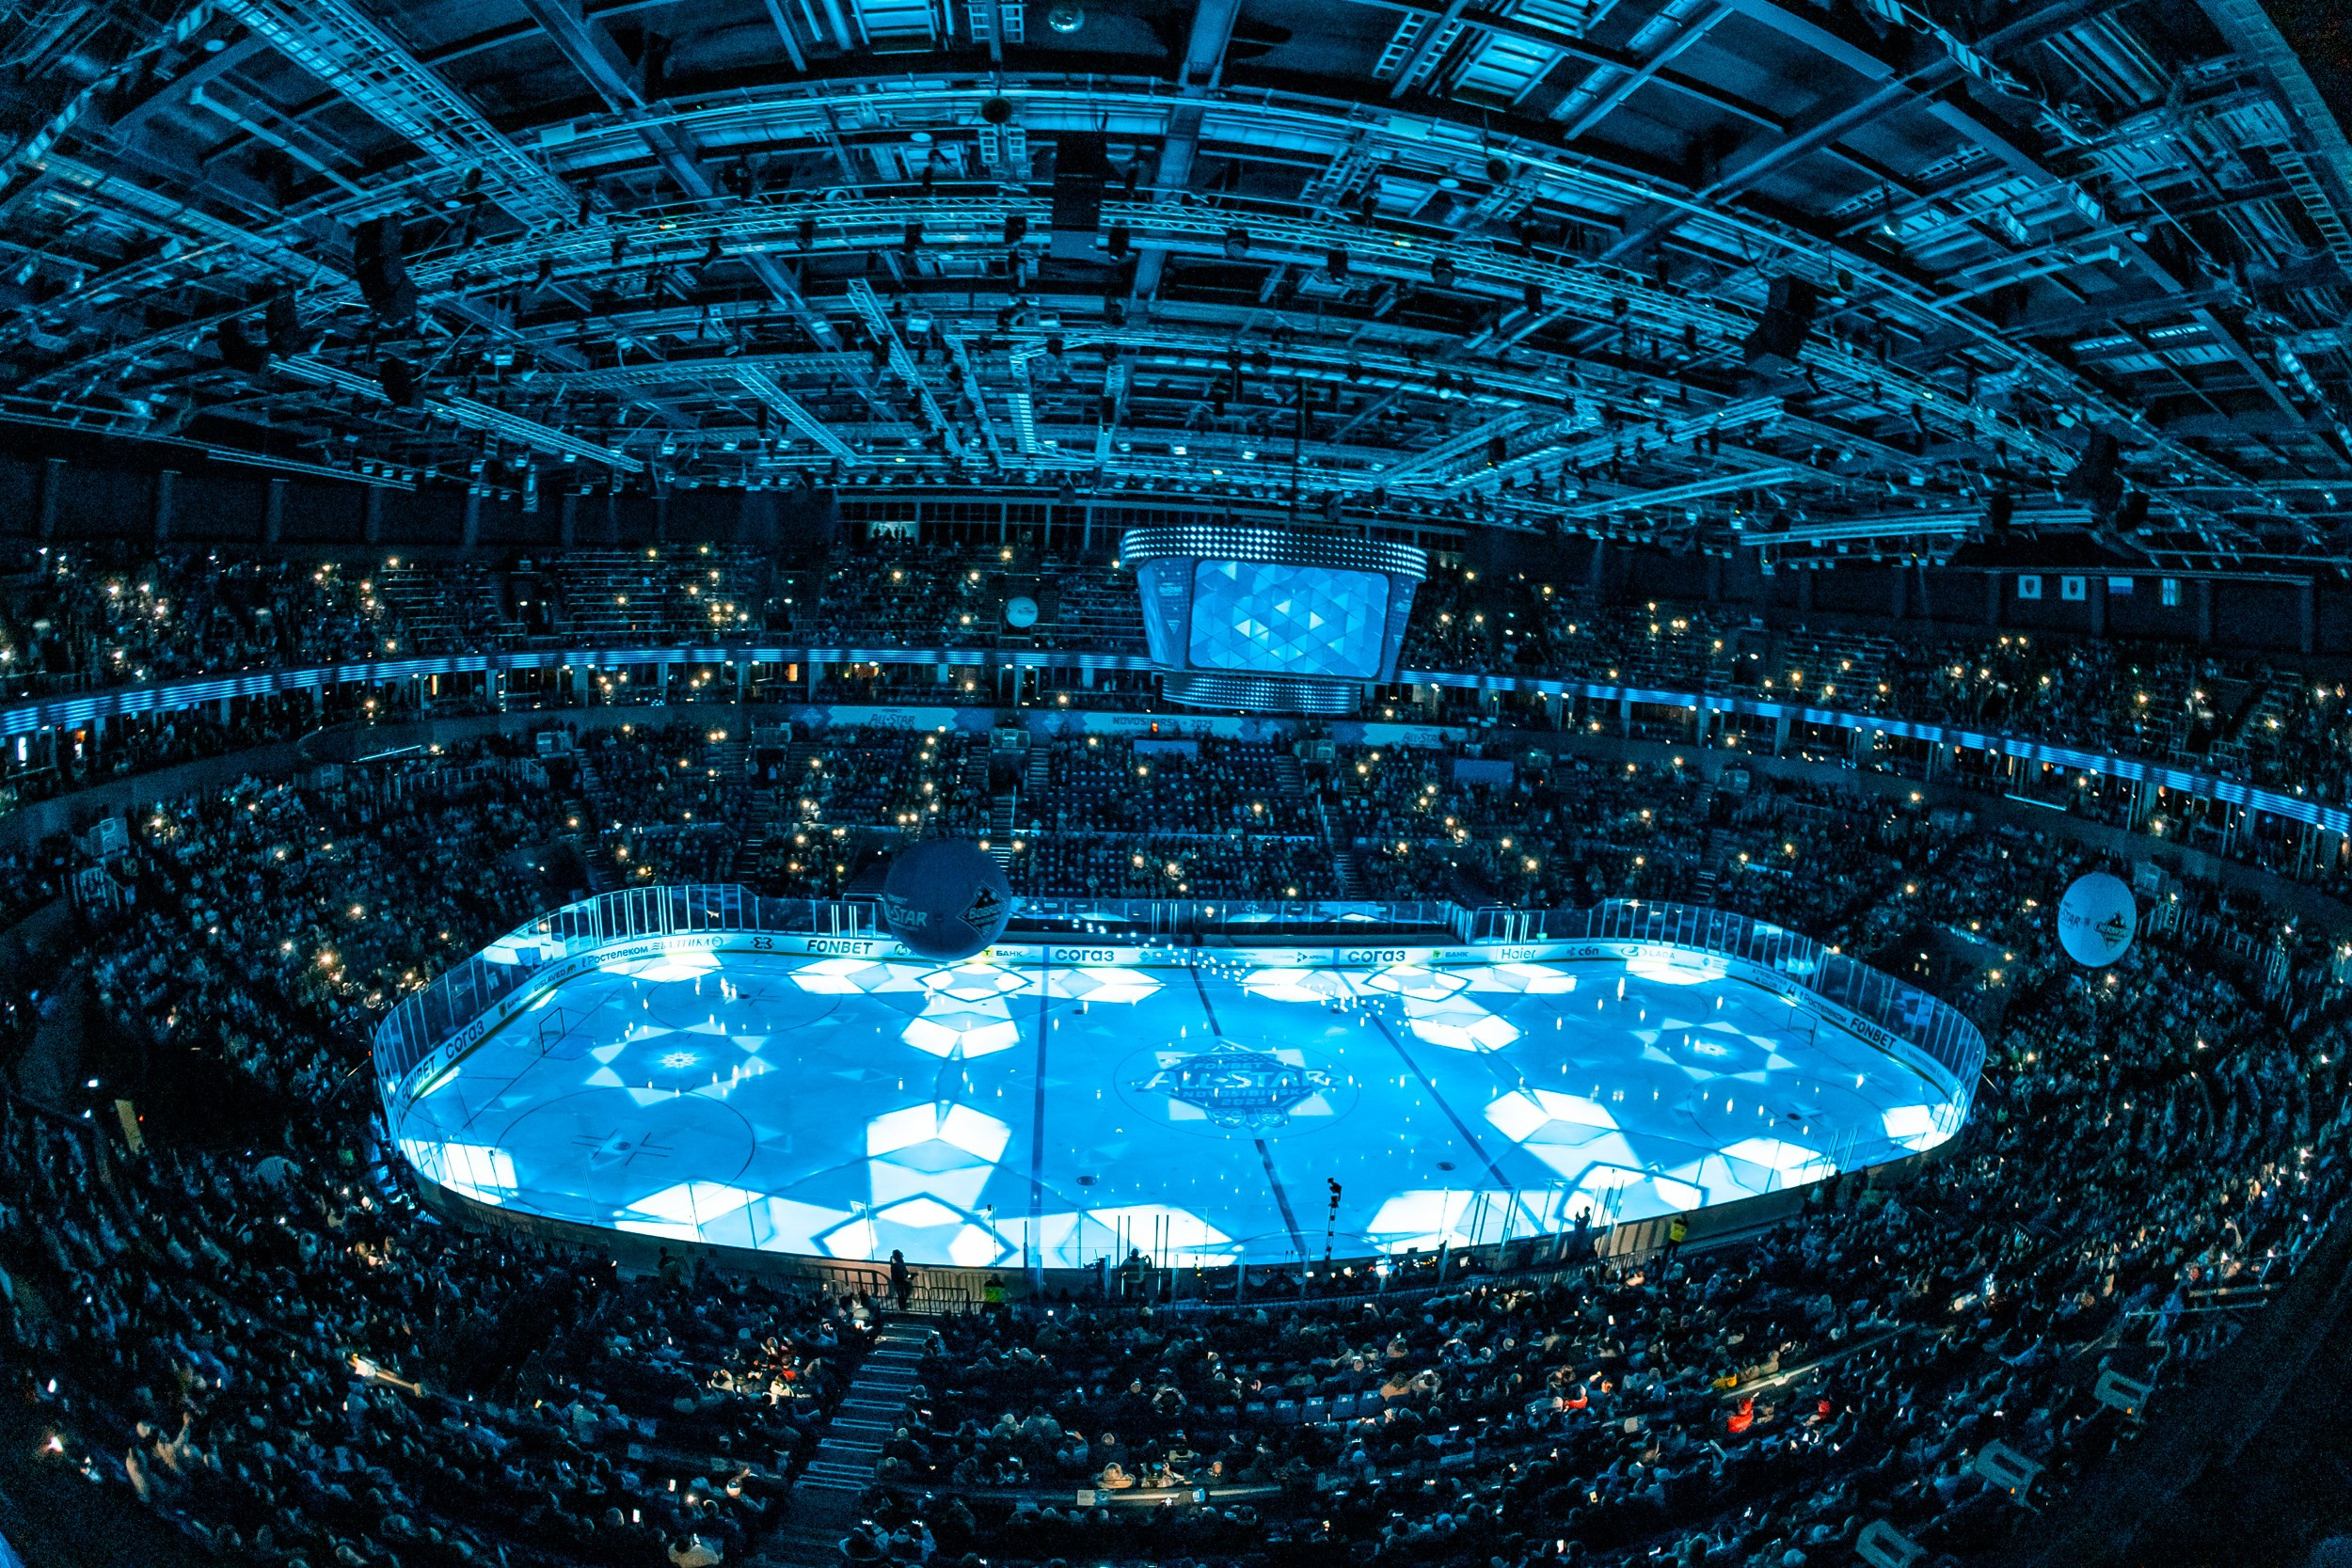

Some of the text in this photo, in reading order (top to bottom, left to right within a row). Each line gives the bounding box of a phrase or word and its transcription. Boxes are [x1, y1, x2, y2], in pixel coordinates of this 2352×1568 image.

[806, 939, 874, 956] FONBET
[1502, 947, 1536, 959] Haier
[1578, 946, 1599, 957] сбп
[1648, 949, 1677, 960] LADA
[587, 945, 649, 966] Ростелеком
[533, 968, 567, 992] GISLAVED
[1804, 992, 1847, 1023] Ростелеком
[1850, 1017, 1898, 1051] FONBET
[1193, 1062, 1264, 1071] FONBET
[1141, 1069, 1333, 1091] ALL-STAR
[1182, 1088, 1302, 1099] NOVOSIBIRSK
[1220, 1098, 1268, 1108] 2025
